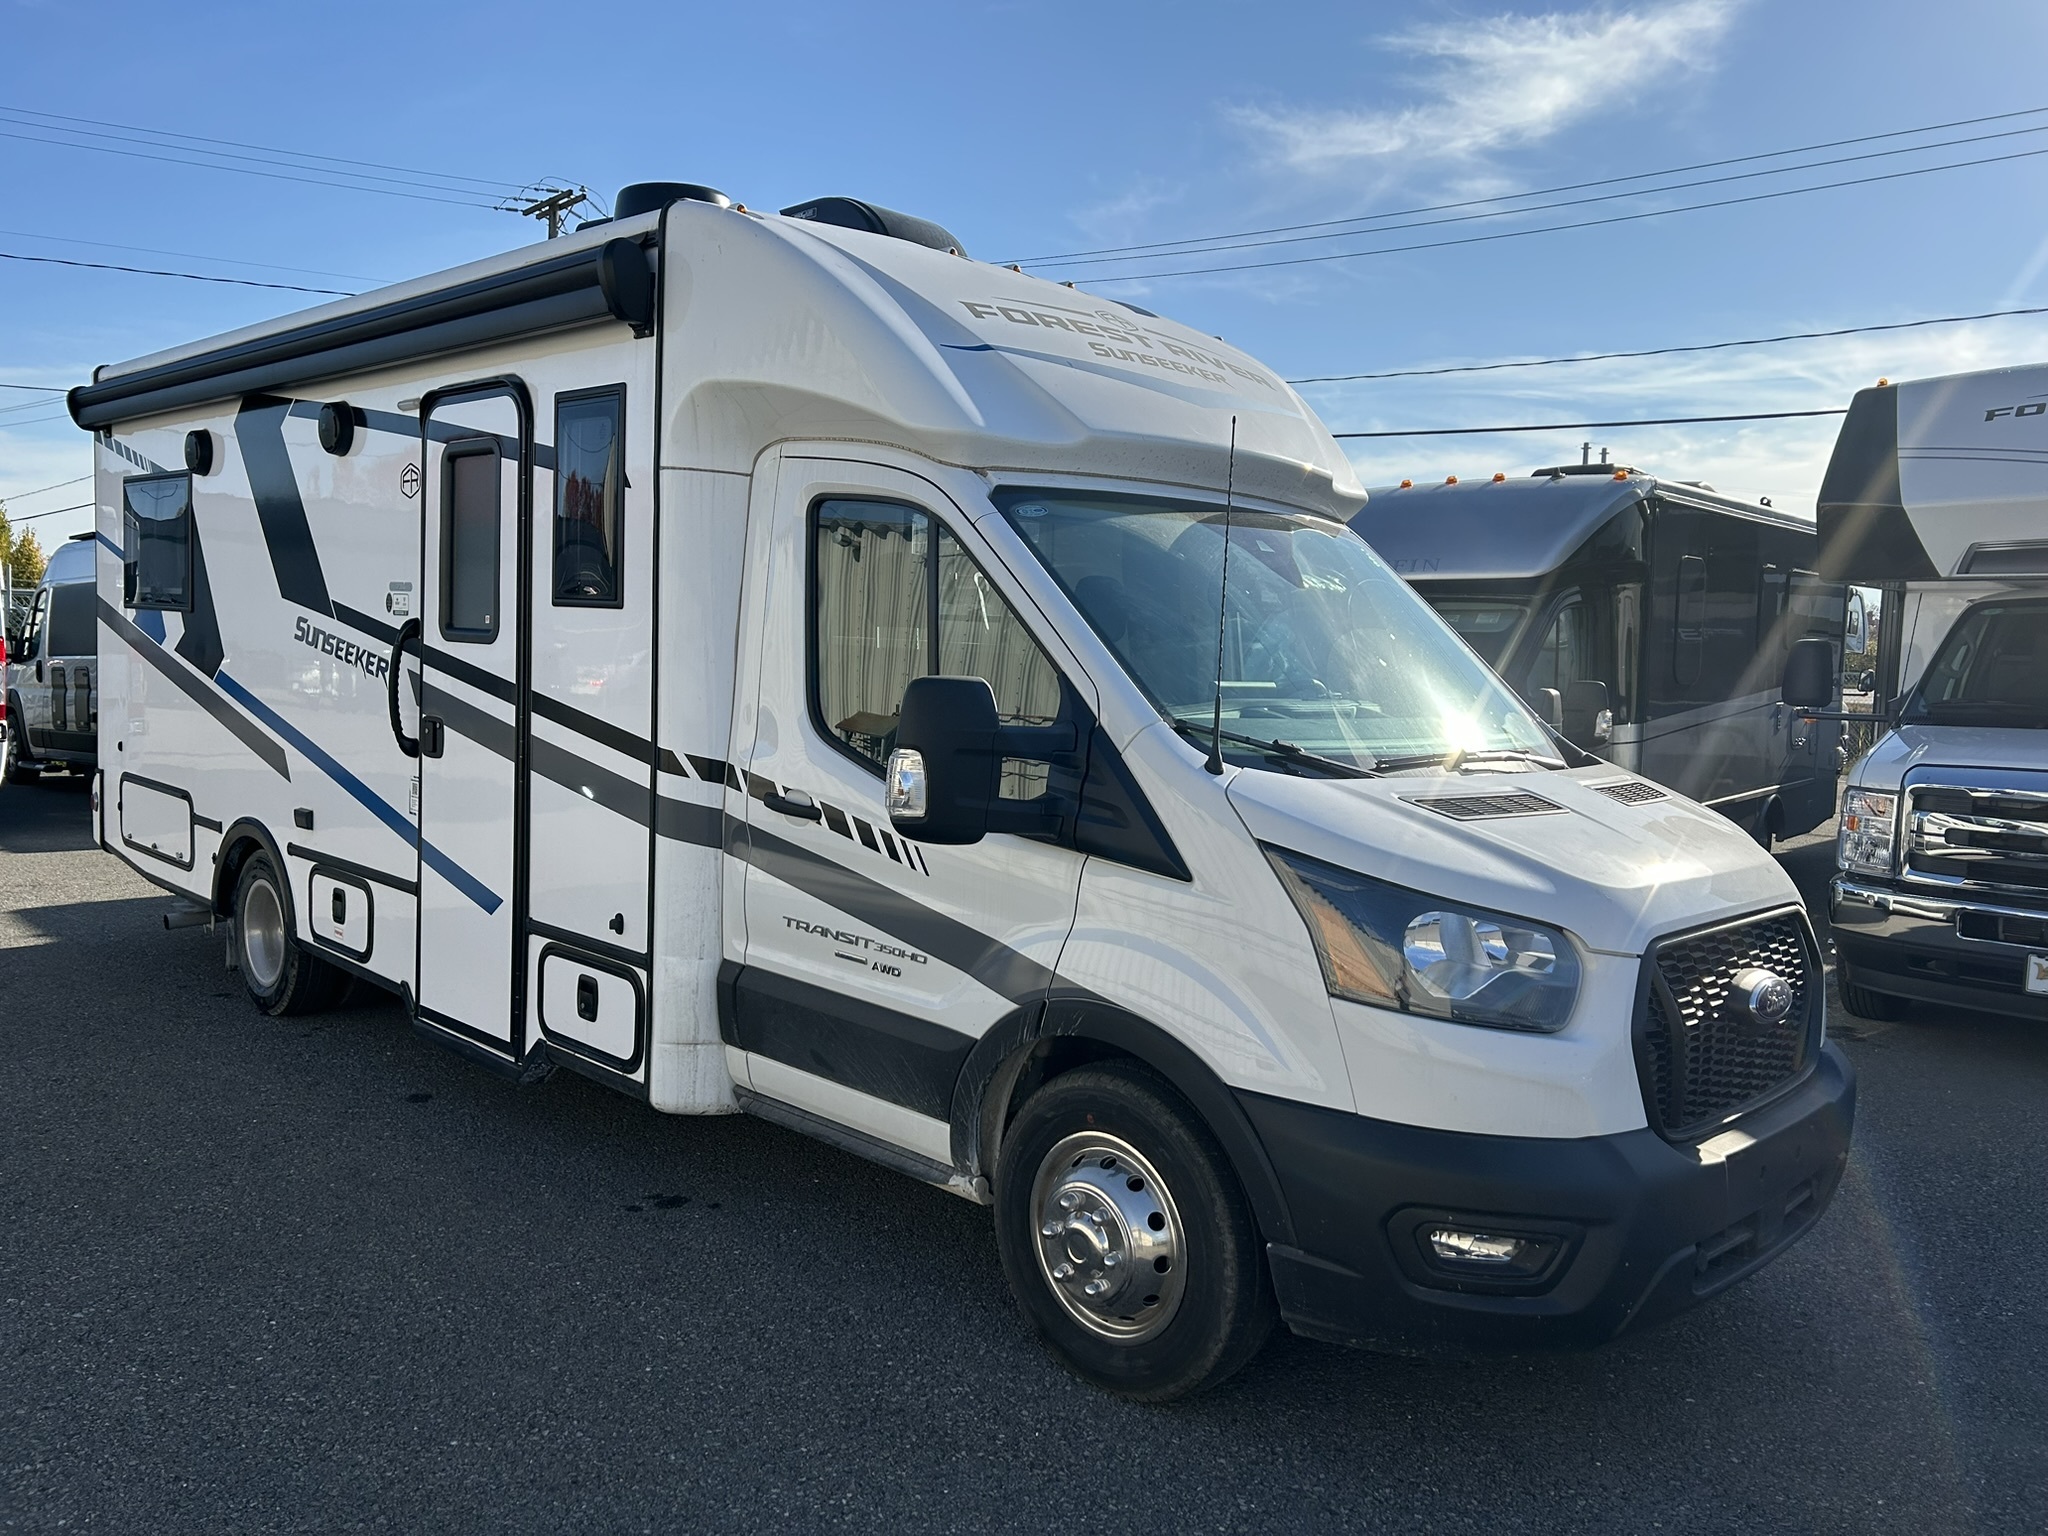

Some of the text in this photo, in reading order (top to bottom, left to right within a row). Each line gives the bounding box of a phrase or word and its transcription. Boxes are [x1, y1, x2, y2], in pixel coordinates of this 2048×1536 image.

[958, 300, 1277, 391] FOREST RIVER
[782, 915, 875, 949] TRANSIT
[871, 961, 902, 978] AWD
